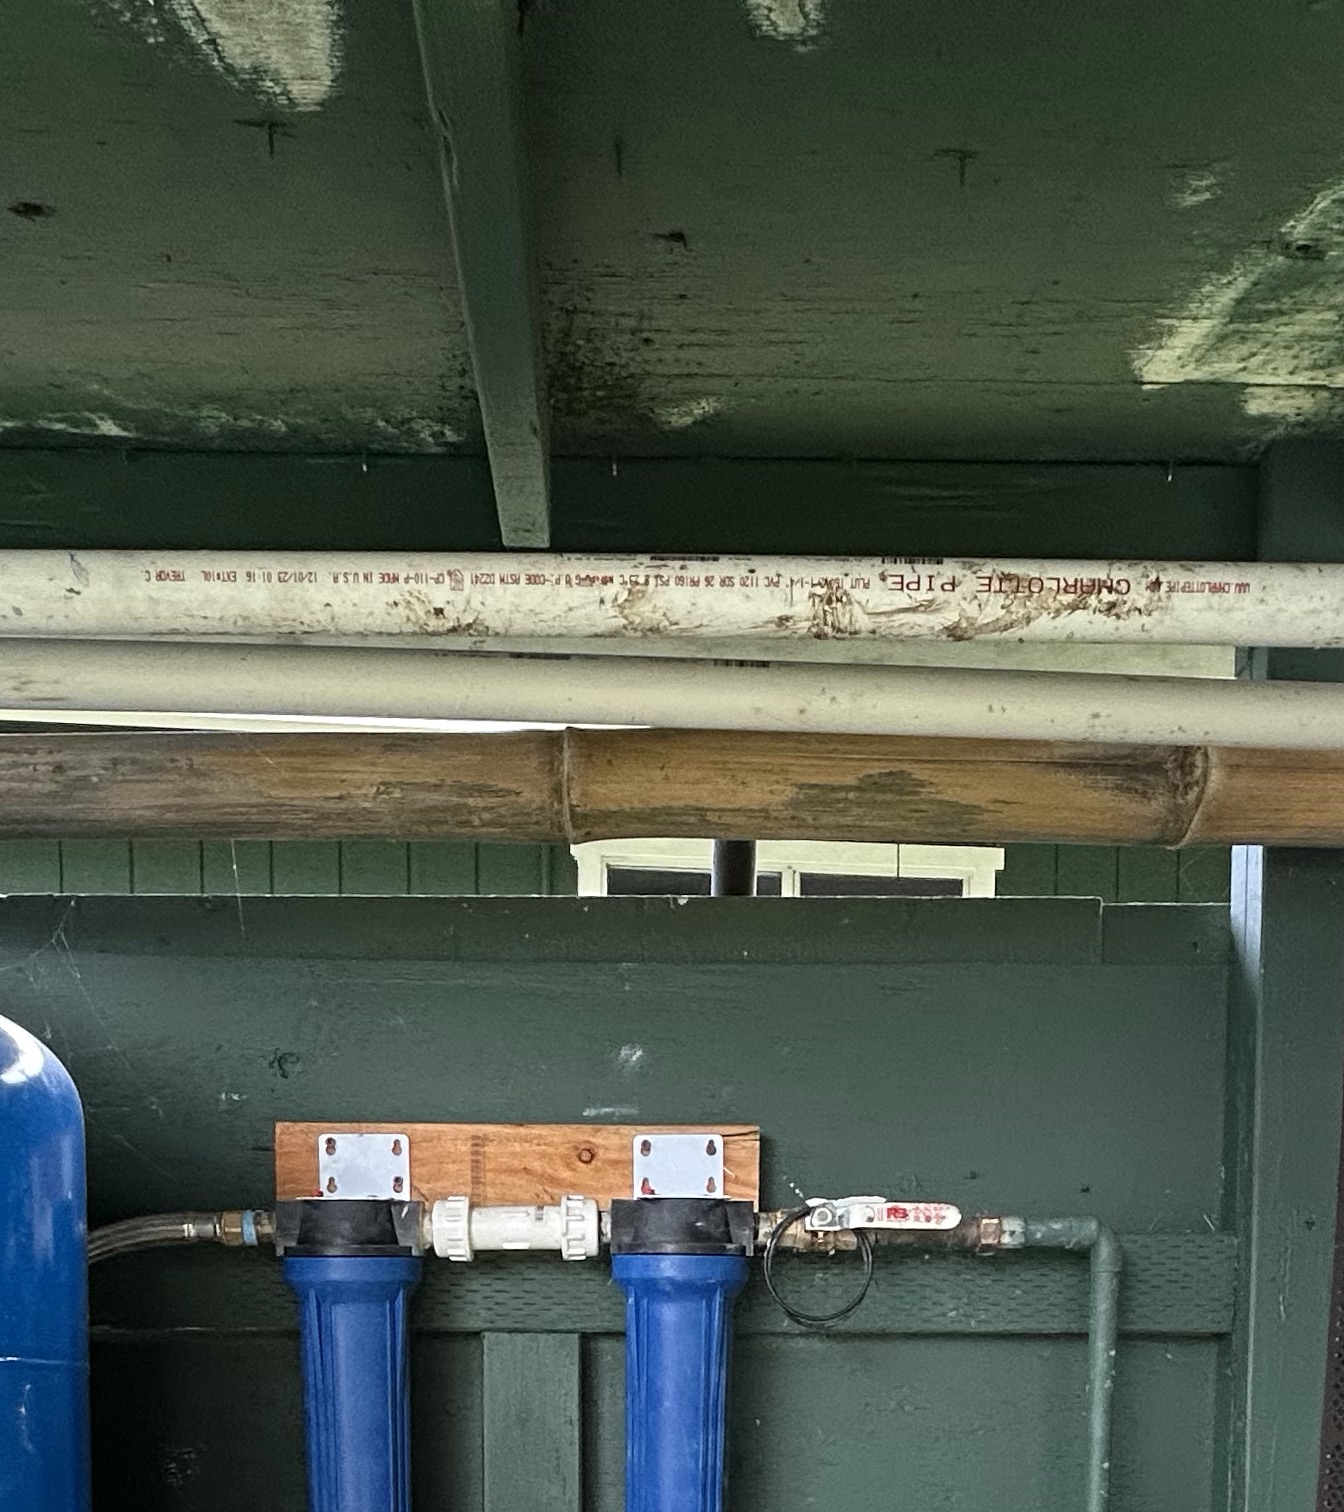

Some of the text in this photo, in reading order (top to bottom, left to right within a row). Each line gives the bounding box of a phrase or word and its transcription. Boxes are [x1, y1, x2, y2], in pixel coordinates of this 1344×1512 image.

[154, 570, 186, 583] TREVOR
[277, 570, 318, 584] 12/01/23
[362, 571, 374, 584] IN
[498, 573, 521, 586] ASTM
[703, 575, 716, 588] 26
